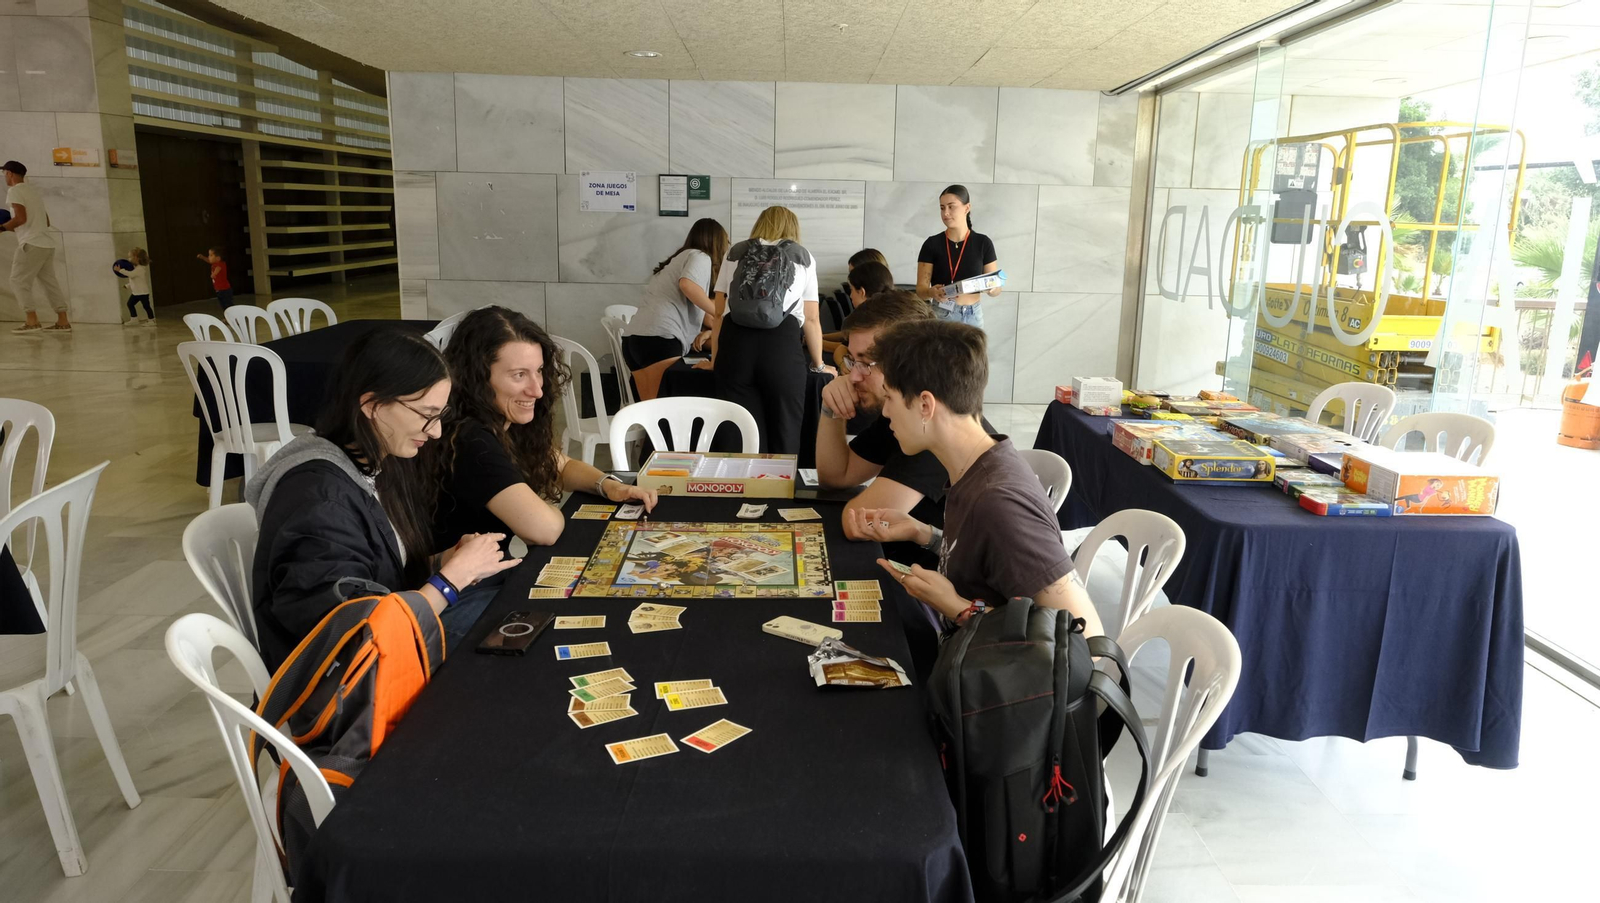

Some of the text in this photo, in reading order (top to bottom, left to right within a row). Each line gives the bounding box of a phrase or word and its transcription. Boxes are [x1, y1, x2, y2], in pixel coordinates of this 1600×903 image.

[1340, 306, 1349, 323] 8
[1349, 319, 1361, 329] AC
[1200, 460, 1244, 477] Splendor
[687, 483, 744, 493] MONOPOLY
